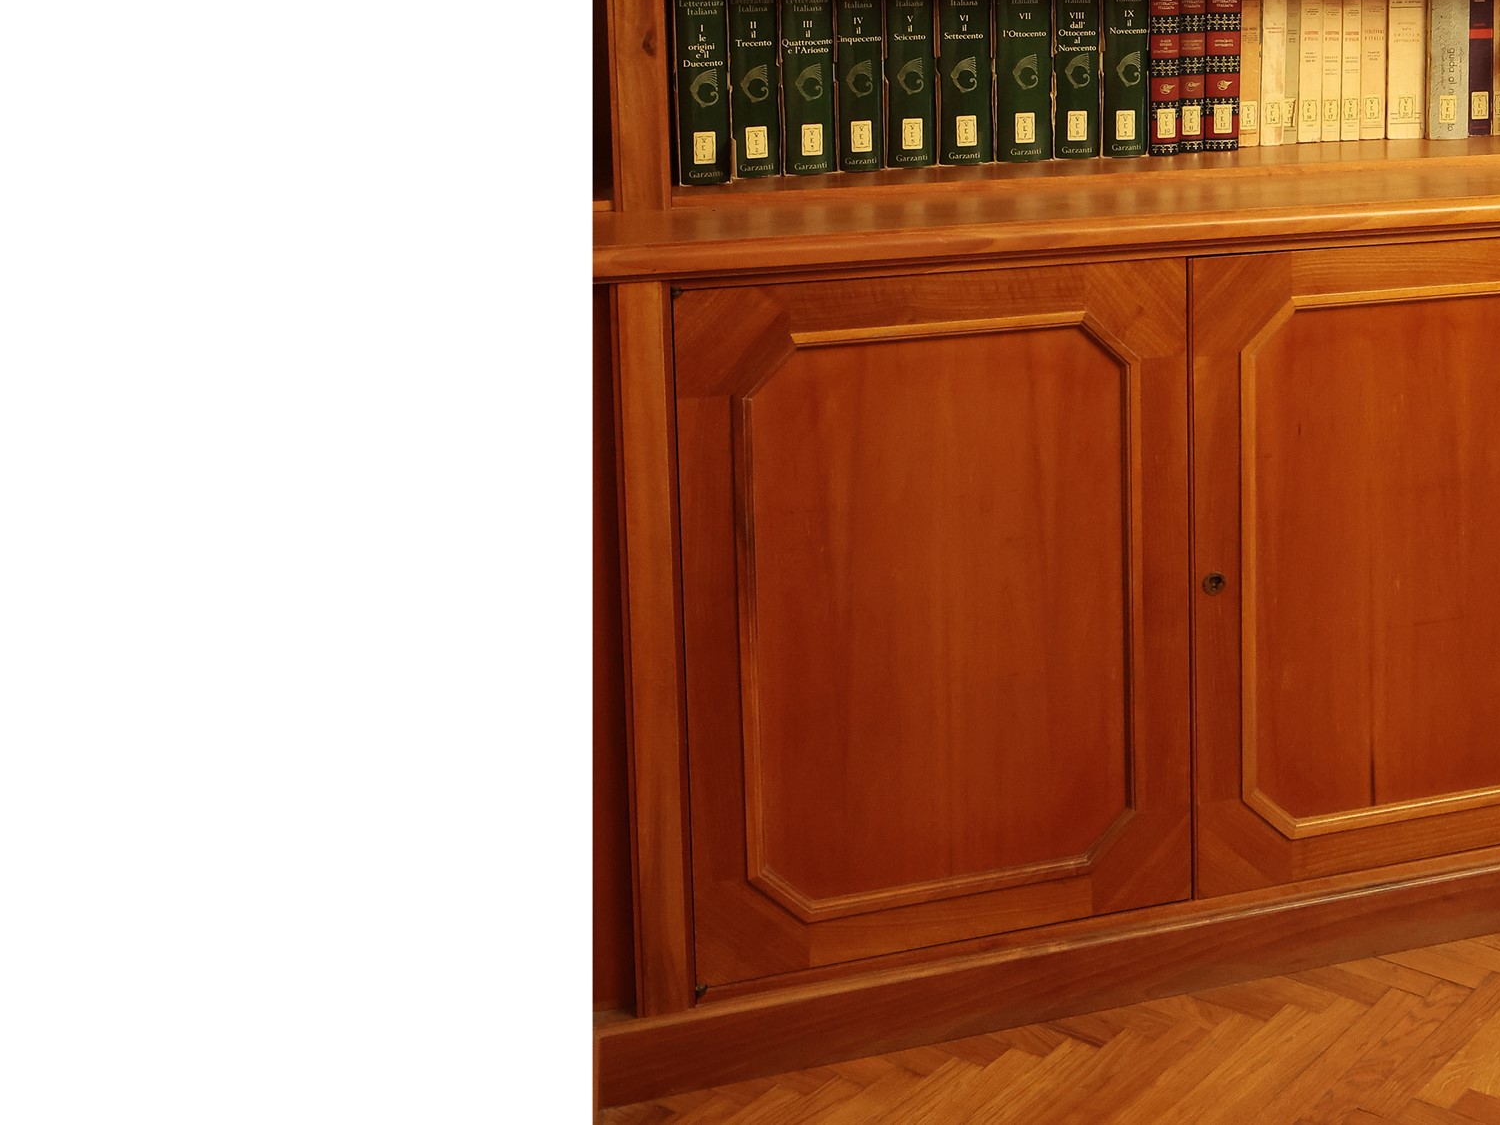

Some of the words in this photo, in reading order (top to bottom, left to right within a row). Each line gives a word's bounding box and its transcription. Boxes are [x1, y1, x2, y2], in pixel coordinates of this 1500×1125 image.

[679, 0, 724, 7] Letteratura
[844, 1, 873, 9] Italiana
[950, 0, 978, 7] Italiana
[687, 7, 718, 15] Italiana
[738, 5, 768, 13] Italiana
[1124, 9, 1134, 17] IX
[906, 15, 914, 23] V
[960, 15, 969, 23] VI
[1018, 12, 1032, 20] VII
[1069, 11, 1085, 19] VIII
[749, 21, 757, 29] II
[853, 17, 864, 25] IV
[1069, 21, 1086, 29] dall'
[750, 31, 757, 39] il
[1002, 29, 1047, 38] l'Ottocento
[1058, 29, 1096, 37] Ottocento
[1110, 27, 1148, 35] Novecento
[698, 34, 707, 42] le
[894, 33, 926, 41] Seicento
[944, 31, 984, 41] Settecento
[1074, 36, 1080, 44] al
[735, 39, 772, 47] Trecento
[782, 39, 833, 48] Quattrocento
[688, 43, 715, 53] origini
[795, 46, 829, 55] l'Ariosto
[1058, 43, 1097, 53] Novecento
[683, 59, 724, 68] Duecento
[1061, 145, 1093, 155] Garzanti
[1111, 142, 1142, 153] Garzanti
[948, 151, 982, 161] Garzanti
[1010, 147, 1042, 157] Garzanti
[844, 157, 878, 166] Garzanti
[896, 152, 929, 163] Garzanti
[740, 163, 774, 172] Garzanti
[794, 161, 828, 171] Garzanti
